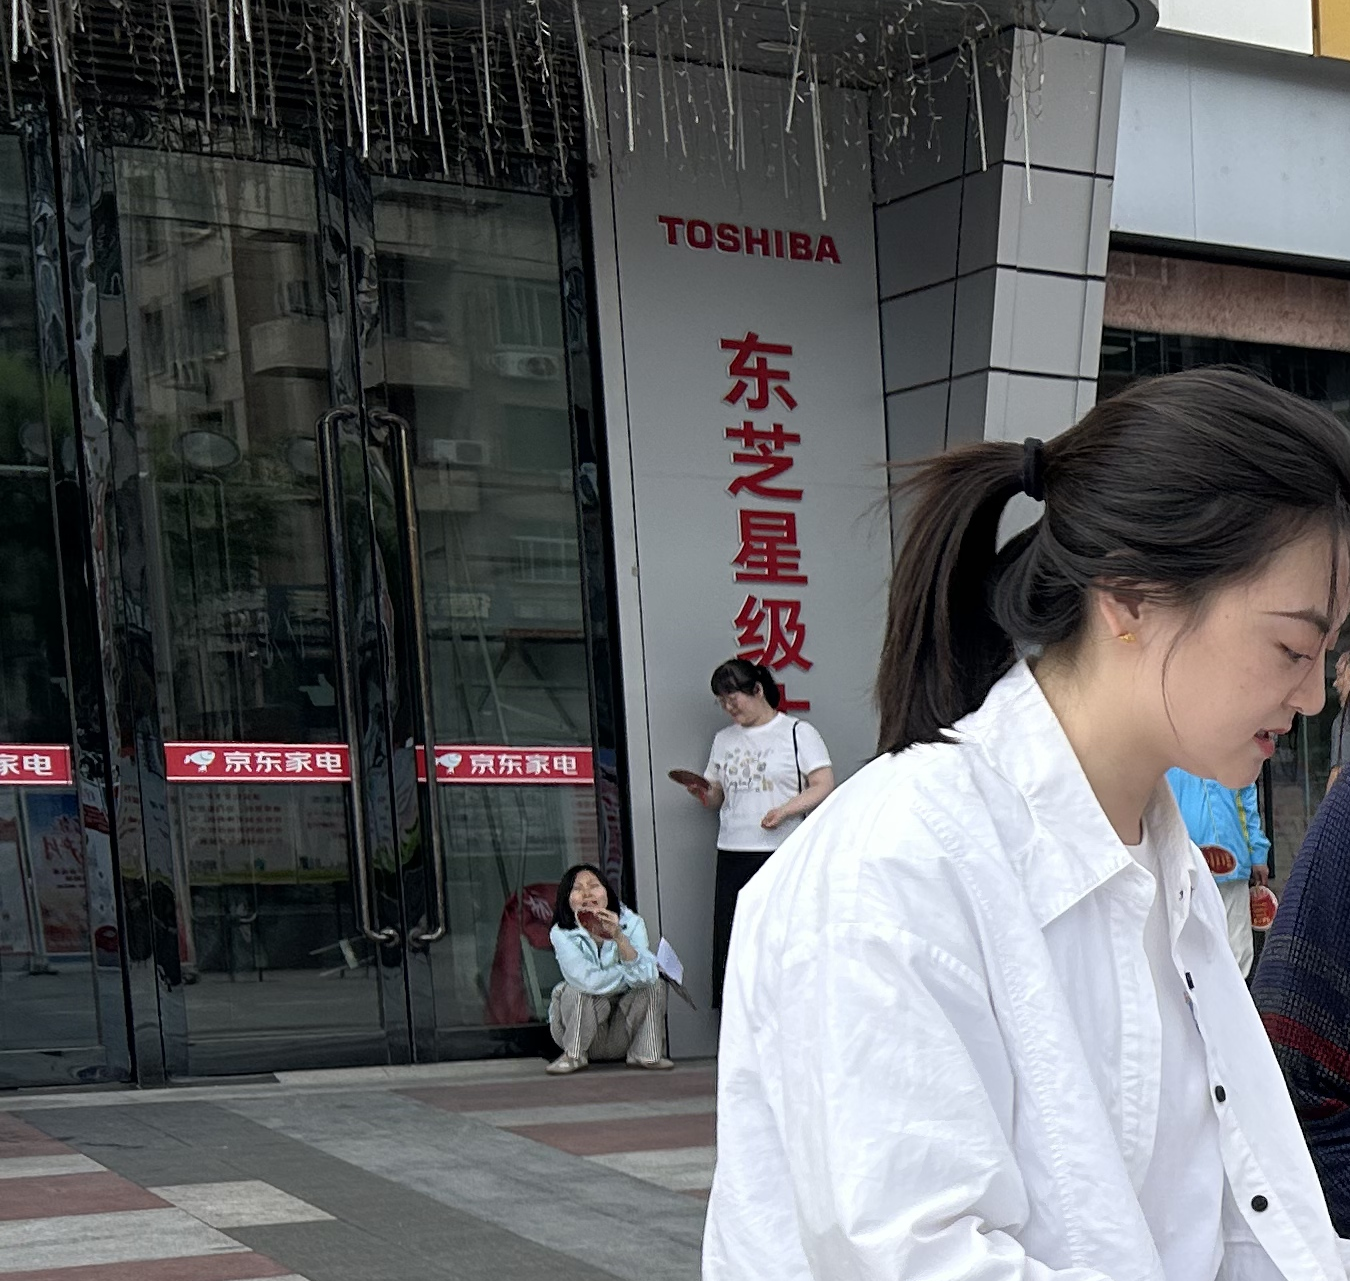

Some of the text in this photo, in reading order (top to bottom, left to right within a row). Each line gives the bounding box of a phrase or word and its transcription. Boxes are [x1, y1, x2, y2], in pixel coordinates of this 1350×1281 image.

[657, 214, 841, 266] TOSHIBA
[718, 331, 815, 713] 东芝星级
[224, 750, 343, 775] 京东家电
[469, 752, 578, 776] 京东家电
